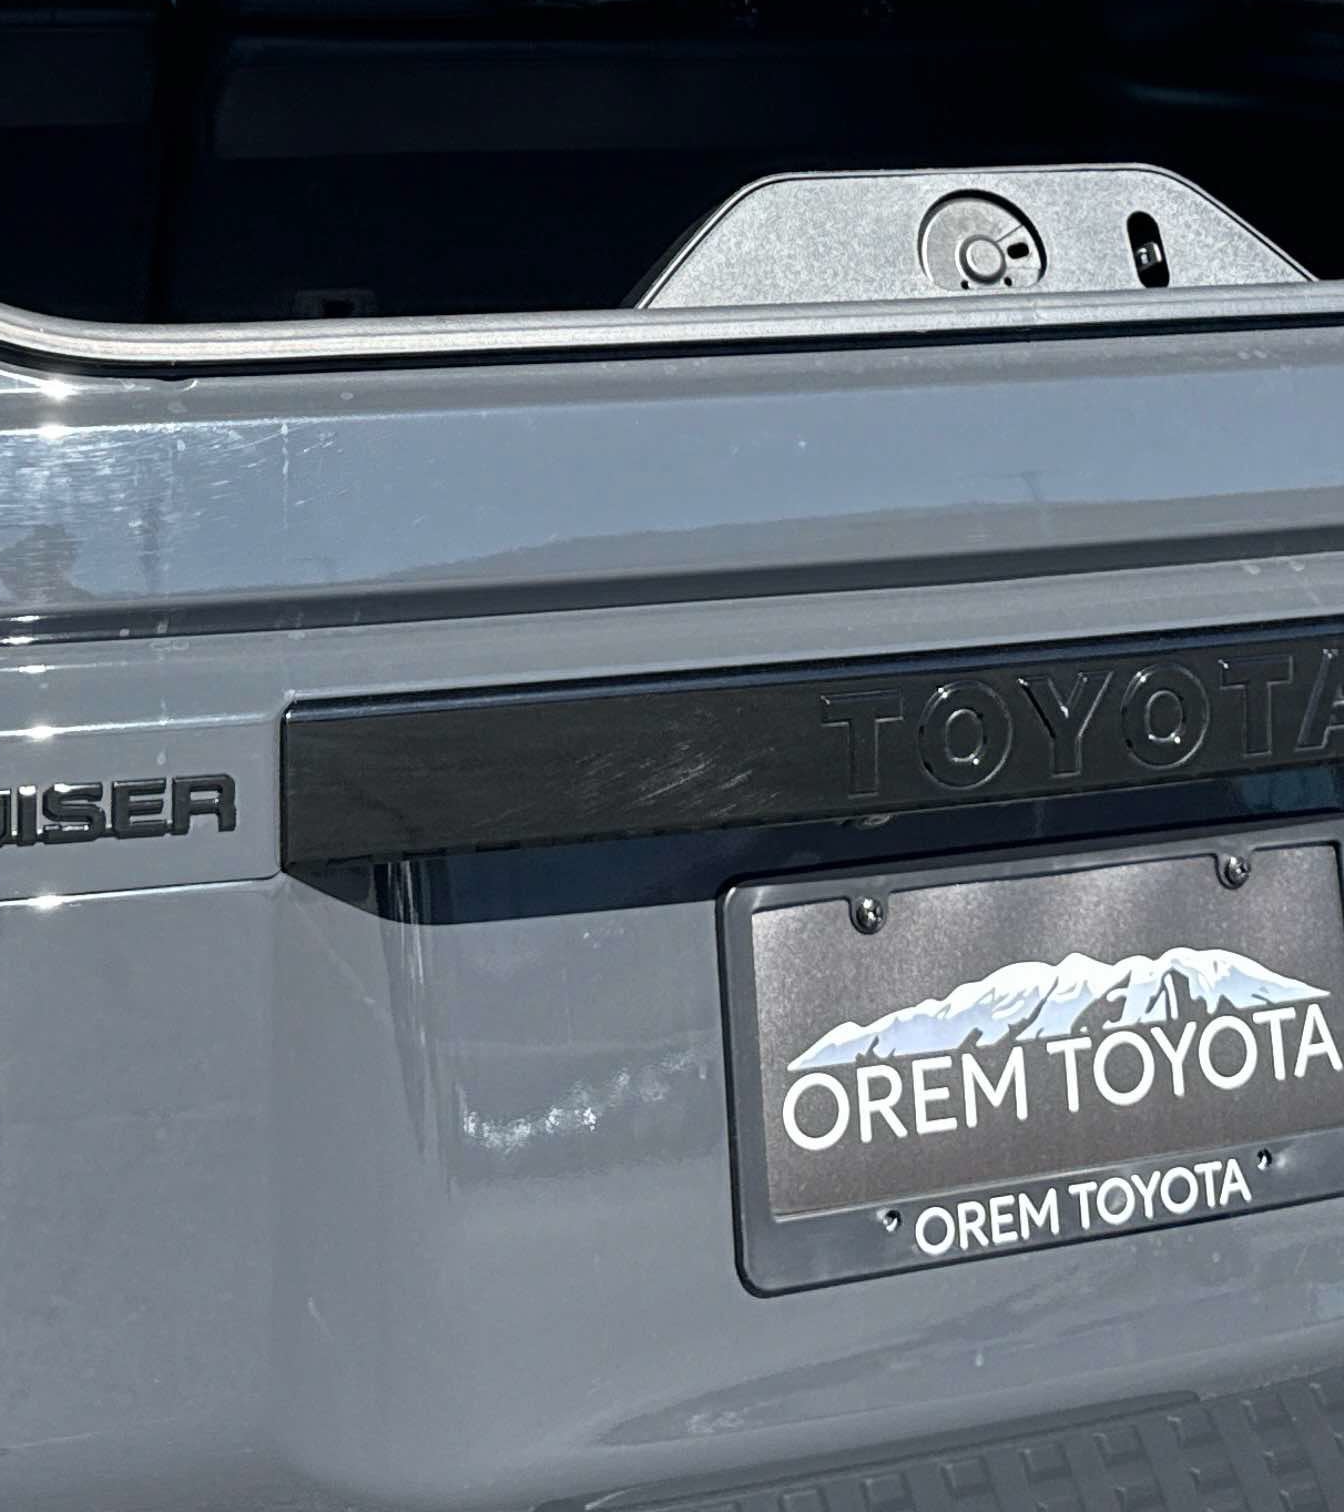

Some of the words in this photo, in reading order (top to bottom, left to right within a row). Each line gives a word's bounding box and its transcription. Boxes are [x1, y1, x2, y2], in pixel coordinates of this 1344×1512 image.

[781, 1045, 1029, 1152] OREM
[1046, 1002, 1344, 1113] TOYOTA
[914, 1187, 1060, 1256] OREM
[1068, 1157, 1253, 1230] TOYOTA
